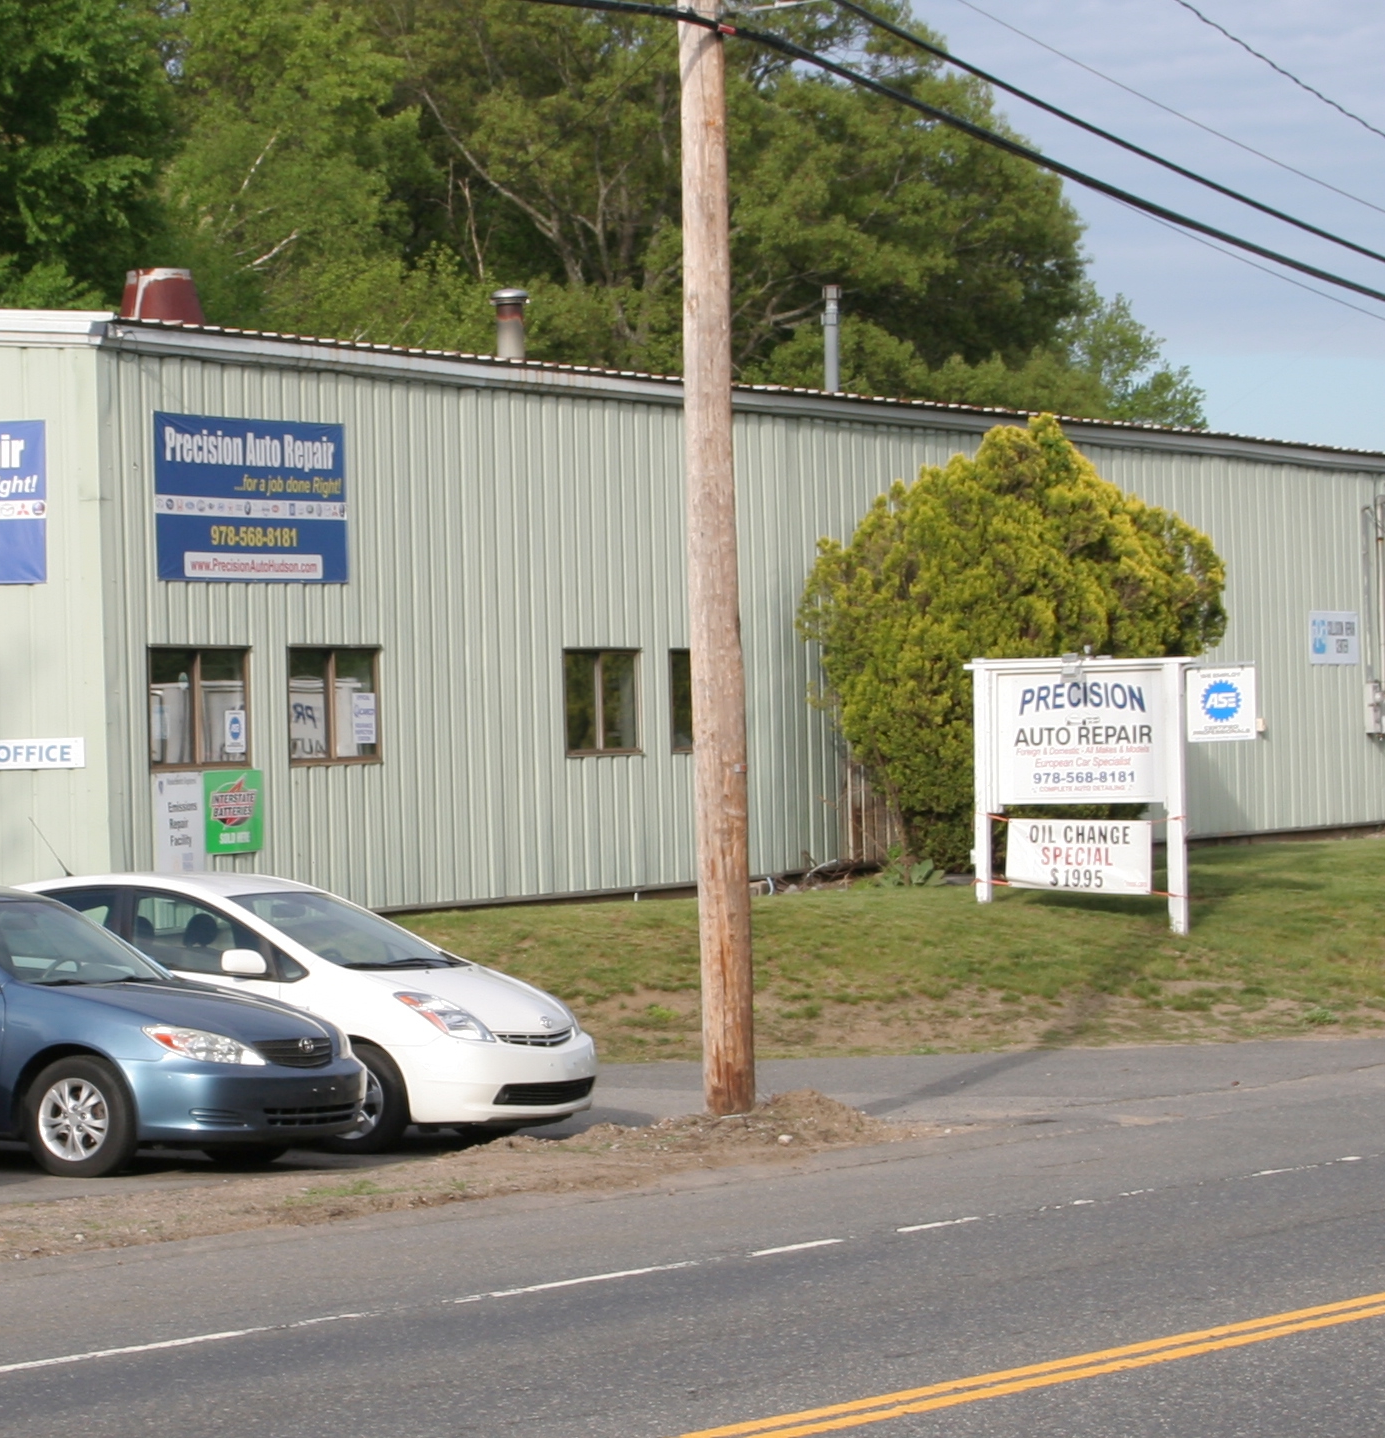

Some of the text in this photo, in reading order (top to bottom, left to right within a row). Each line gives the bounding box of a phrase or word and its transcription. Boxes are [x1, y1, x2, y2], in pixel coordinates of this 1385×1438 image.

[165, 426, 334, 472] Precision Auto Repair
[259, 478, 265, 491] a
[266, 475, 283, 496] job
[286, 477, 310, 493] done
[312, 477, 341, 498] Right!
[211, 526, 298, 547] 978-568-8181
[190, 558, 317, 573] www.PrecisionAutoHudson.com
[1019, 682, 1146, 716] PRECISION
[1206, 692, 1236, 709] ASE
[1014, 724, 1153, 747] AUTO REPAIR
[1016, 748, 1041, 757] Foreign
[1035, 757, 1131, 769] European Car Specialist
[1033, 771, 1135, 784] 978-568-8181
[212, 793, 255, 804] INTERSTATE
[168, 801, 197, 813] Emissions
[214, 806, 252, 817] BATTERIES
[169, 817, 188, 831] Repair
[170, 834, 192, 847] Facility
[1029, 825, 1131, 845] OIL CHANGE
[1041, 846, 1113, 866] SPECIAL
